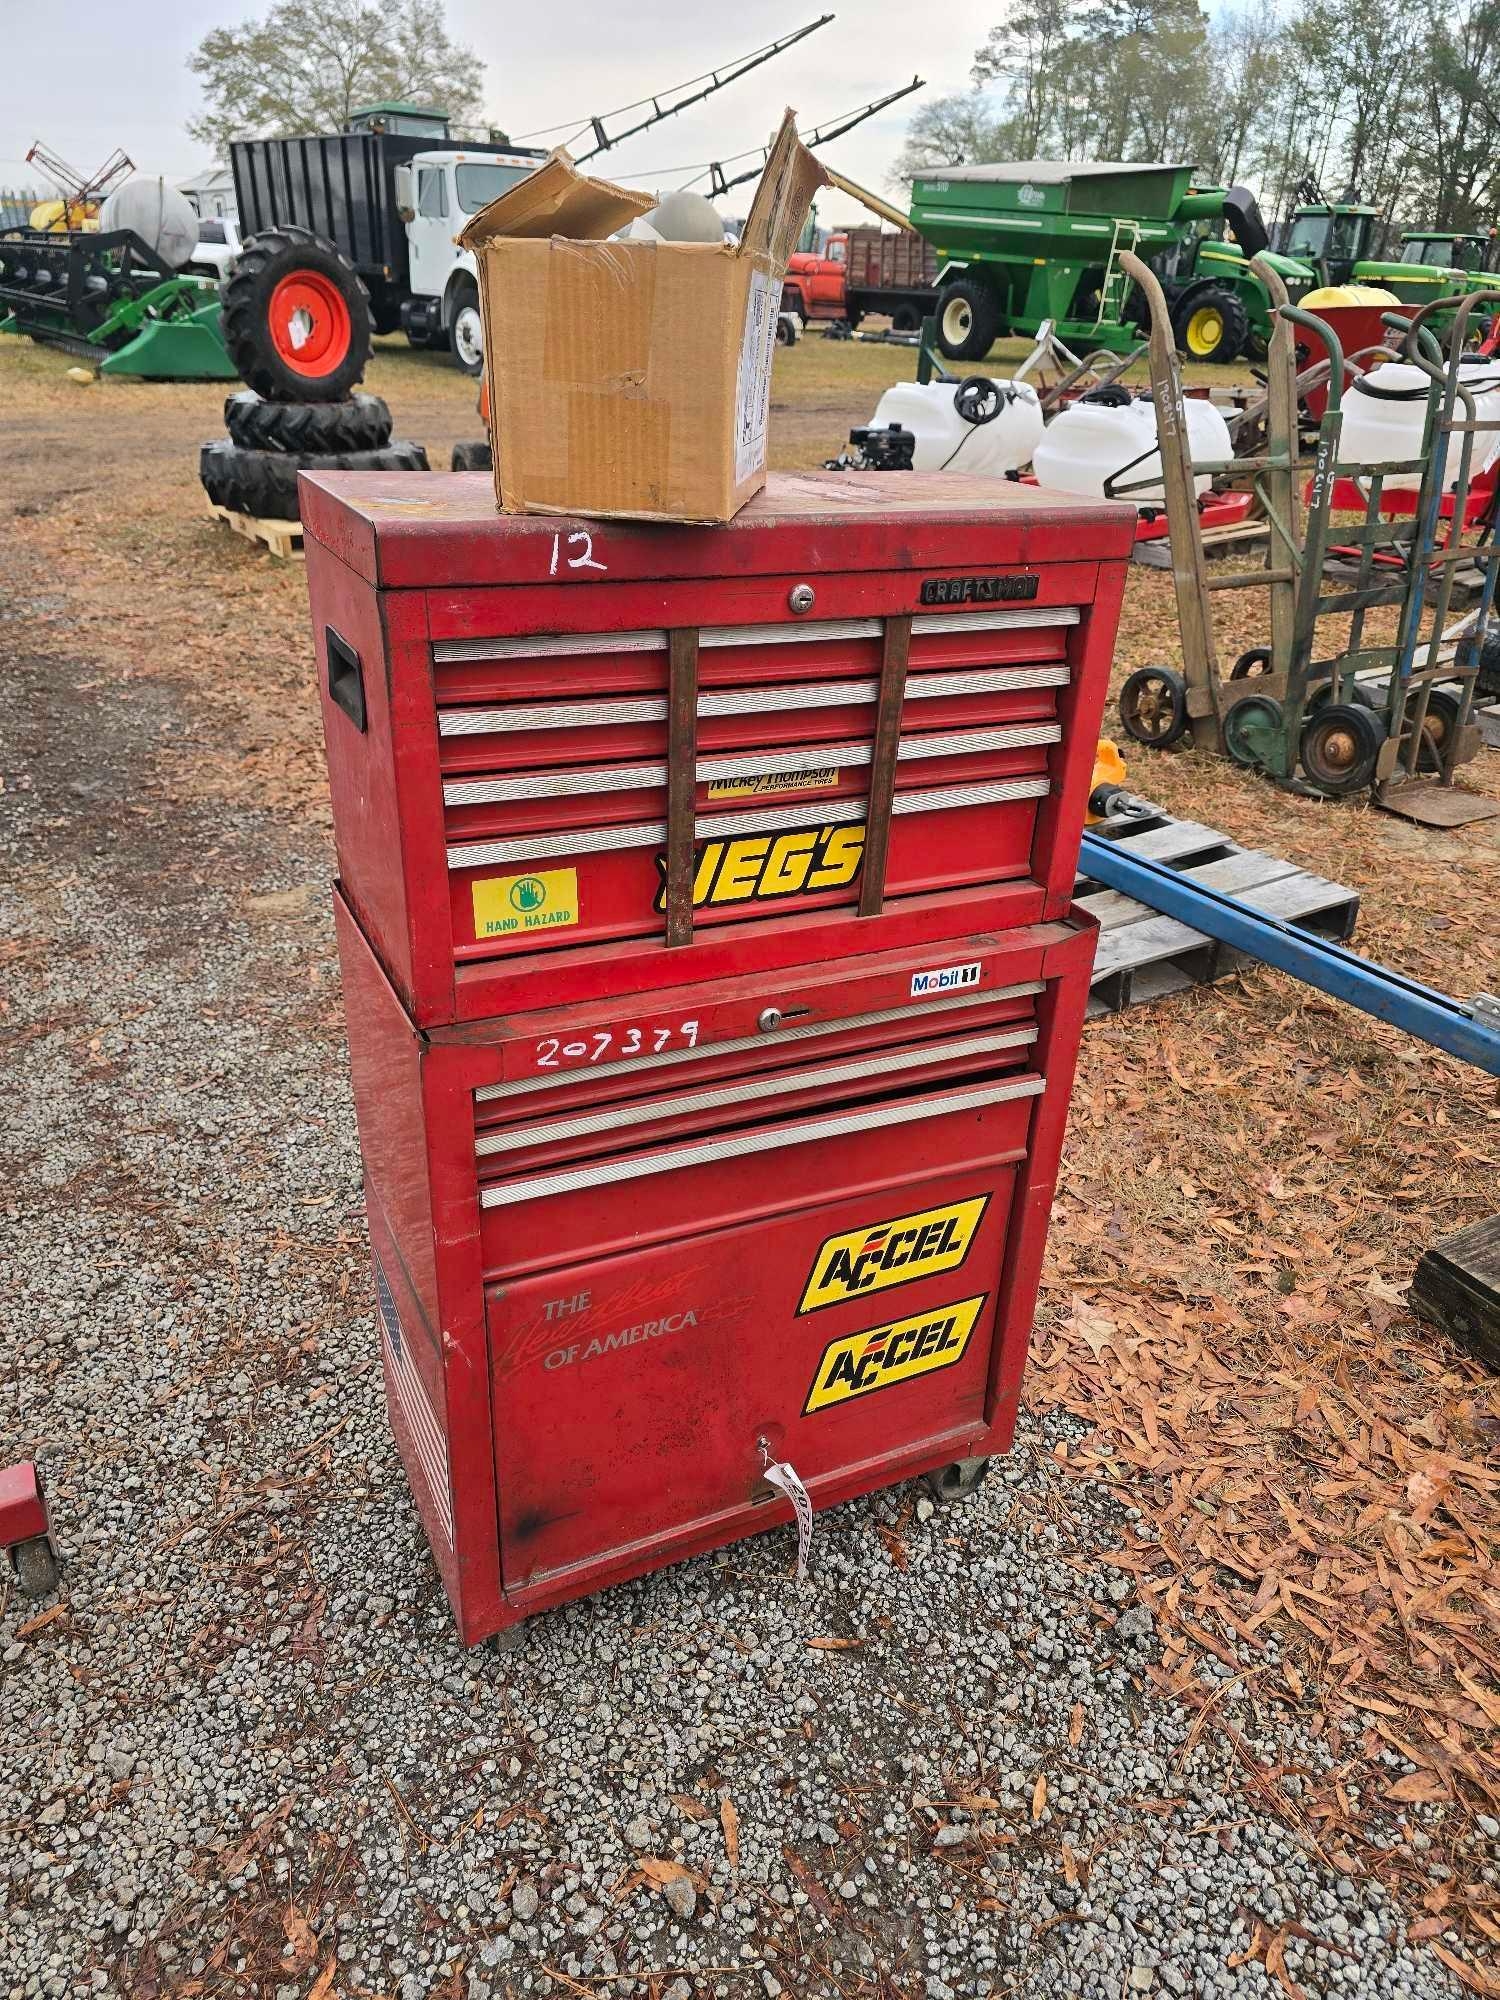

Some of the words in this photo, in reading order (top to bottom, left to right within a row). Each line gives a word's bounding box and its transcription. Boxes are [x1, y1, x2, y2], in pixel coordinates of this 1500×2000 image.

[549, 531, 608, 575] 12
[922, 575, 1040, 604] CRAFTSMAN
[761, 780, 811, 792] PERFORMANCE
[813, 778, 833, 786] TIRES
[486, 918, 519, 933] HAND
[524, 910, 571, 928] HAZARD
[913, 970, 959, 992] Mobil
[961, 966, 978, 983] 1
[536, 1020, 699, 1066] 207379
[817, 1216, 963, 1292] ACCEL
[543, 1289, 593, 1321] THE
[543, 1343, 581, 1370] OF
[581, 1310, 699, 1361] AMERICA
[822, 1315, 961, 1391] ACCEL
